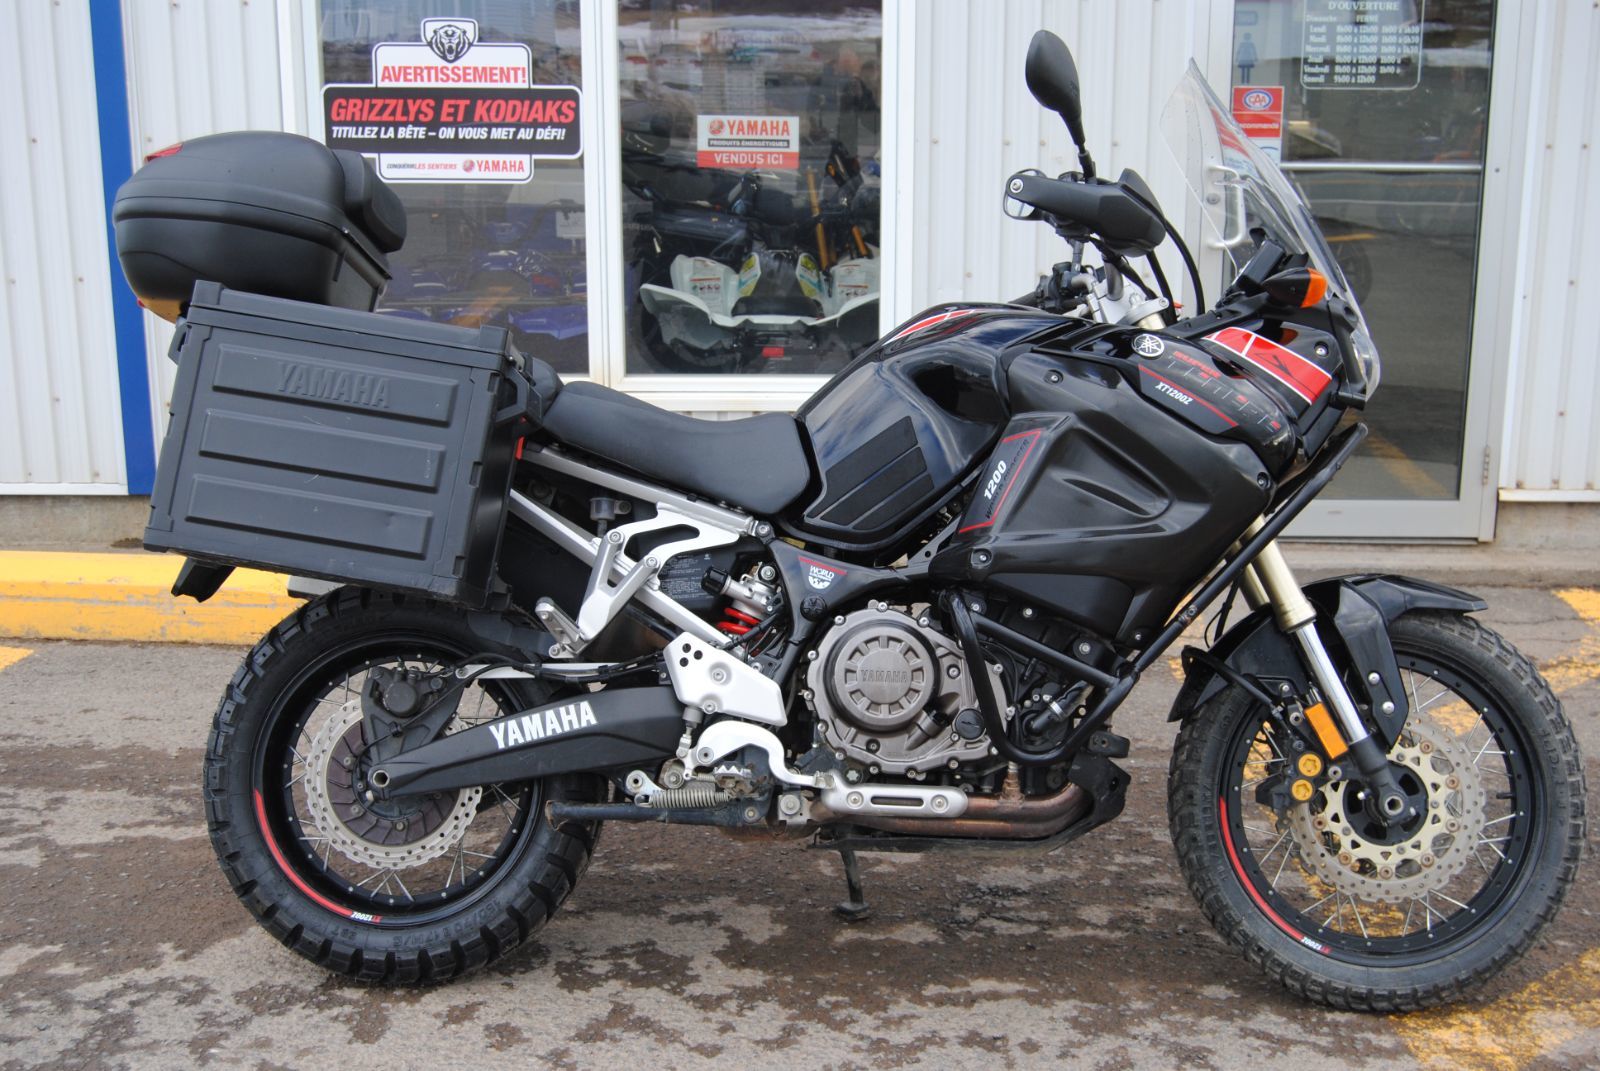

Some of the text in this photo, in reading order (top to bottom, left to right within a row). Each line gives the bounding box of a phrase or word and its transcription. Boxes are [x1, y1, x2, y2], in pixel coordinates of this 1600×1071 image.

[1328, 1, 1400, 11] D'OUVERTURE
[380, 65, 527, 84] AVERTISSEMENT!
[1247, 94, 1266, 106] CAA
[330, 98, 578, 124] GRIZZLYS ET KODIAKS
[331, 126, 379, 139] TITILLEZ
[380, 126, 395, 139] LA
[396, 124, 428, 139] BÊTE
[438, 126, 456, 139] ON
[458, 127, 489, 140] VOUS
[490, 127, 517, 140] MET
[517, 128, 534, 140] AU
[535, 125, 566, 140] DÉFI!
[726, 119, 790, 136] YAMAHA
[415, 162, 426, 170] LES
[476, 159, 525, 173] YAMAHA
[714, 153, 784, 165] VENDUS ICI
[278, 361, 390, 408] YAMAHA
[1155, 381, 1195, 405] XT1200Z
[983, 460, 1007, 500] 1200
[809, 564, 835, 579] WORLD
[861, 669, 908, 683] YAMAHA
[489, 700, 598, 749] YAMAHA
